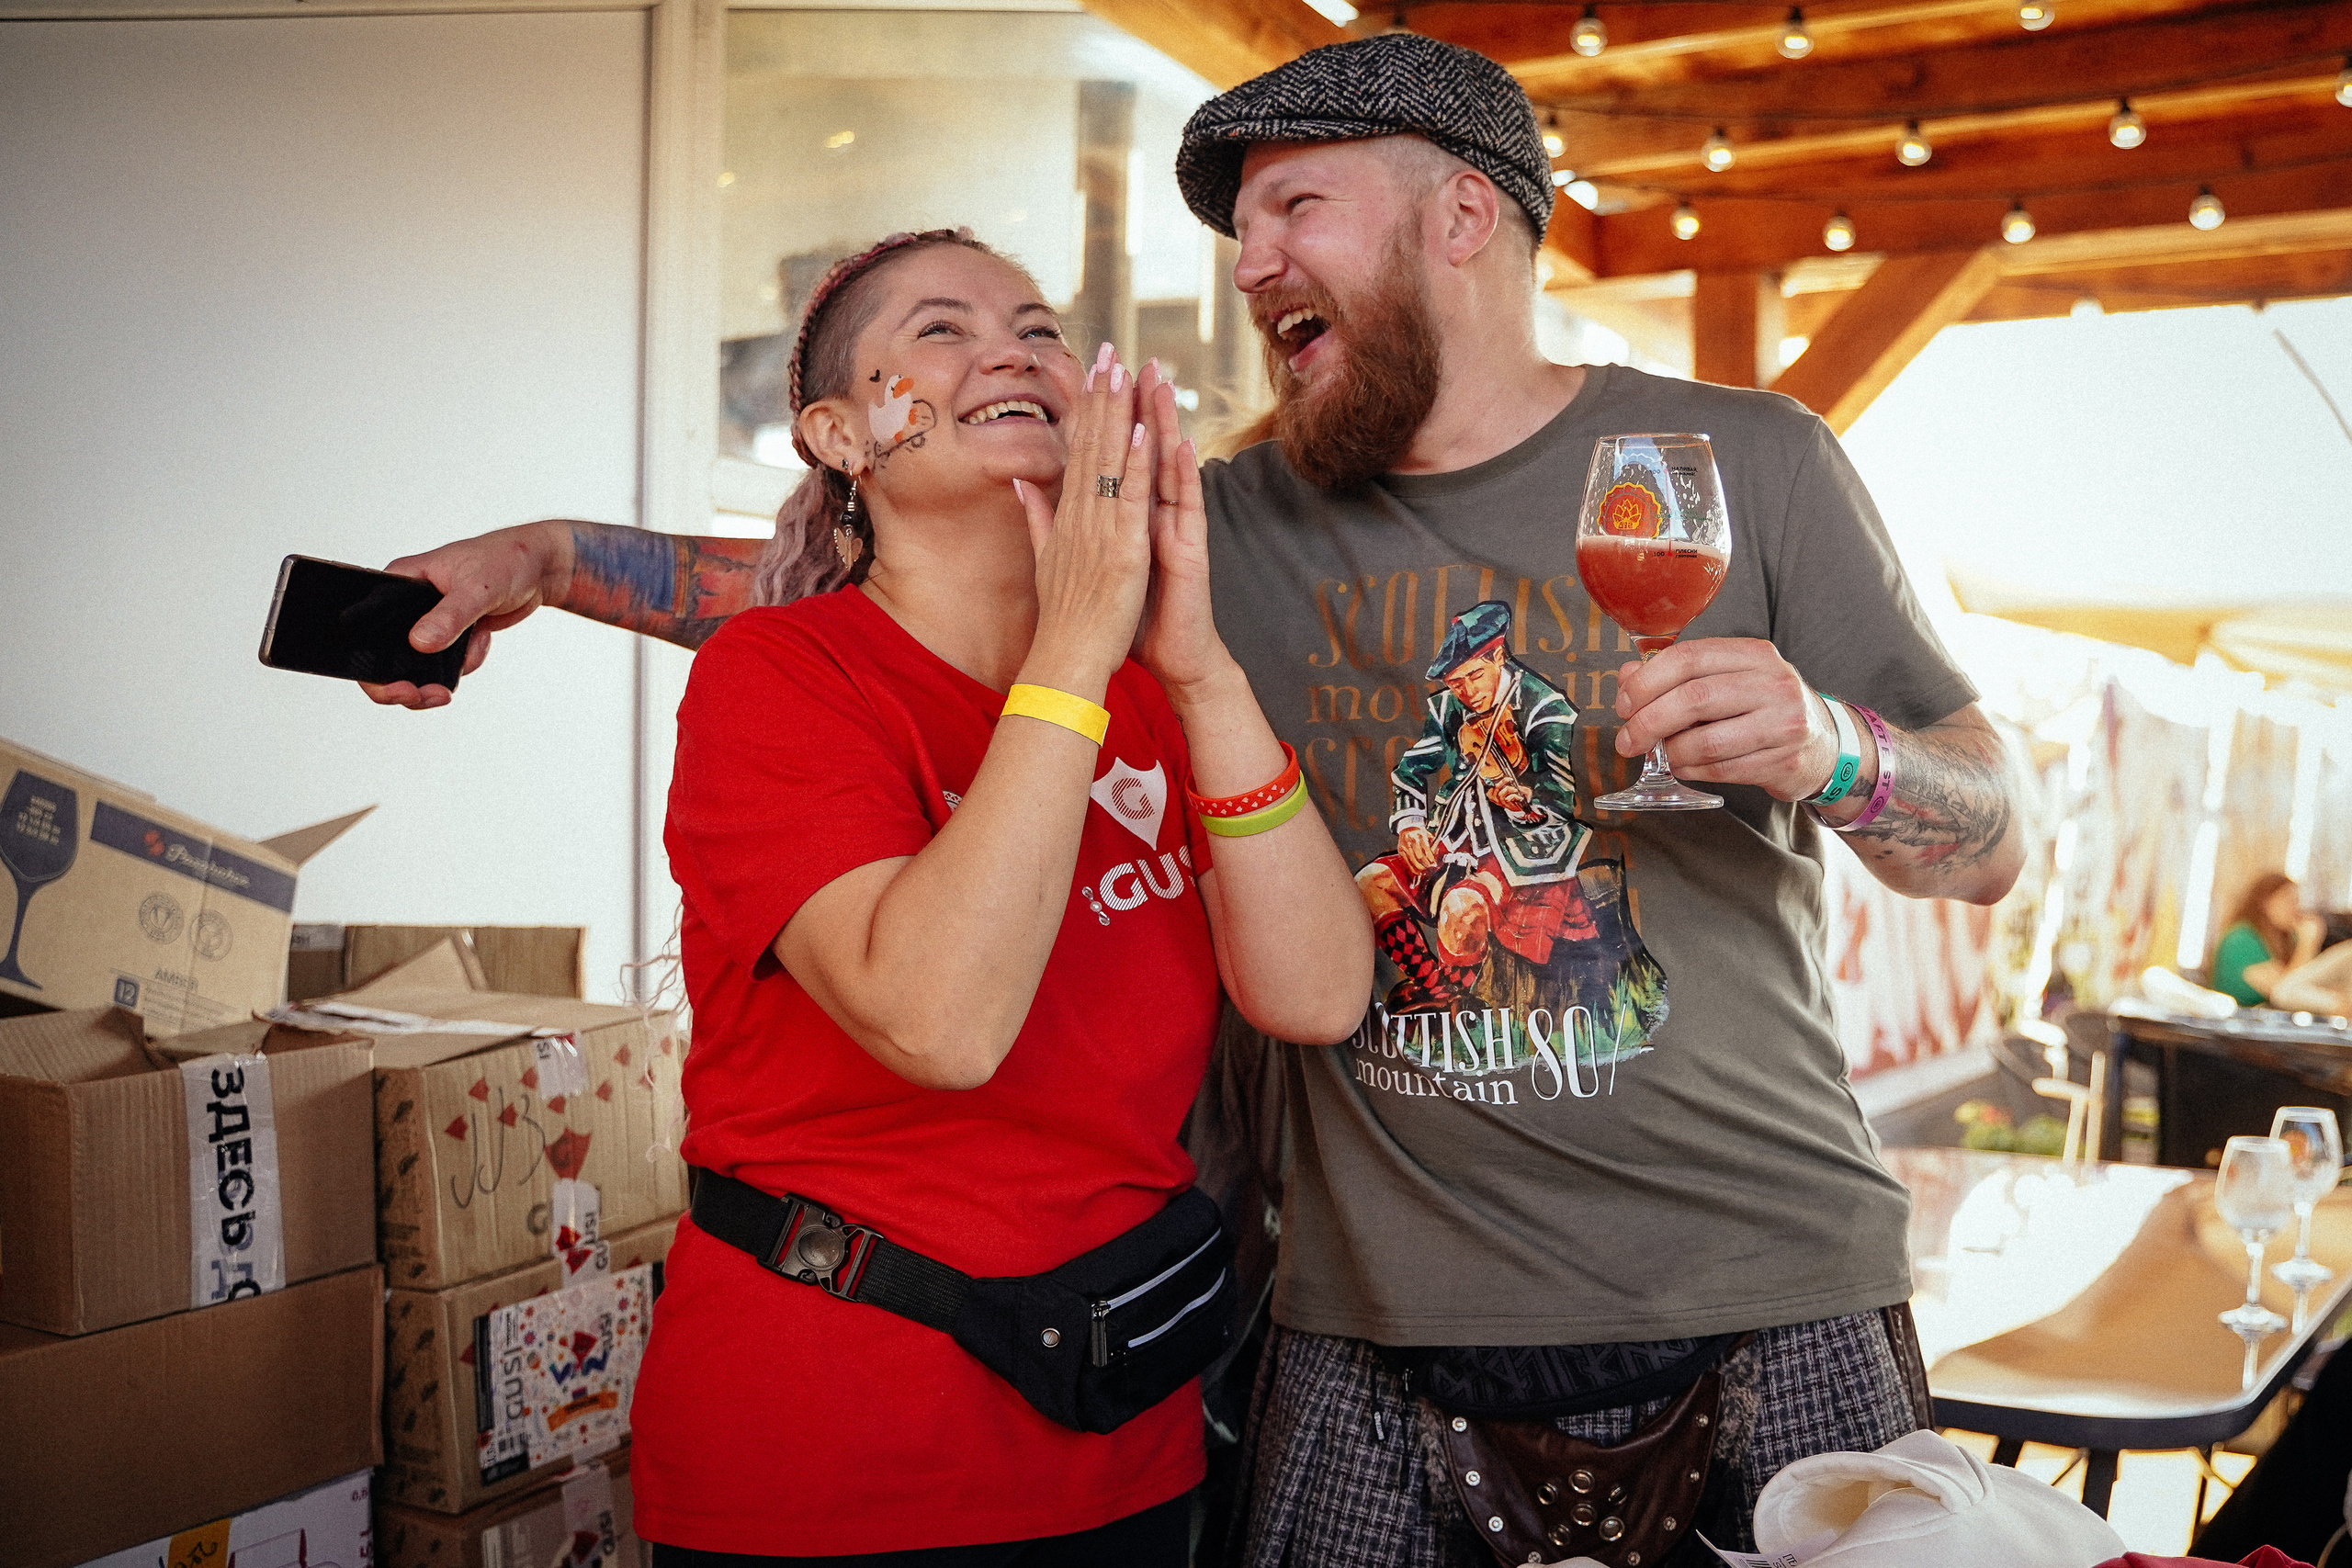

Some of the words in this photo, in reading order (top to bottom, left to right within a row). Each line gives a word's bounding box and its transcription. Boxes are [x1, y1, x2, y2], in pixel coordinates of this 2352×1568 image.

[1881, 745, 1892, 792] FST
[1355, 1056, 1520, 1105] mountain
[206, 1066, 257, 1247] ЗДЕСЬ
